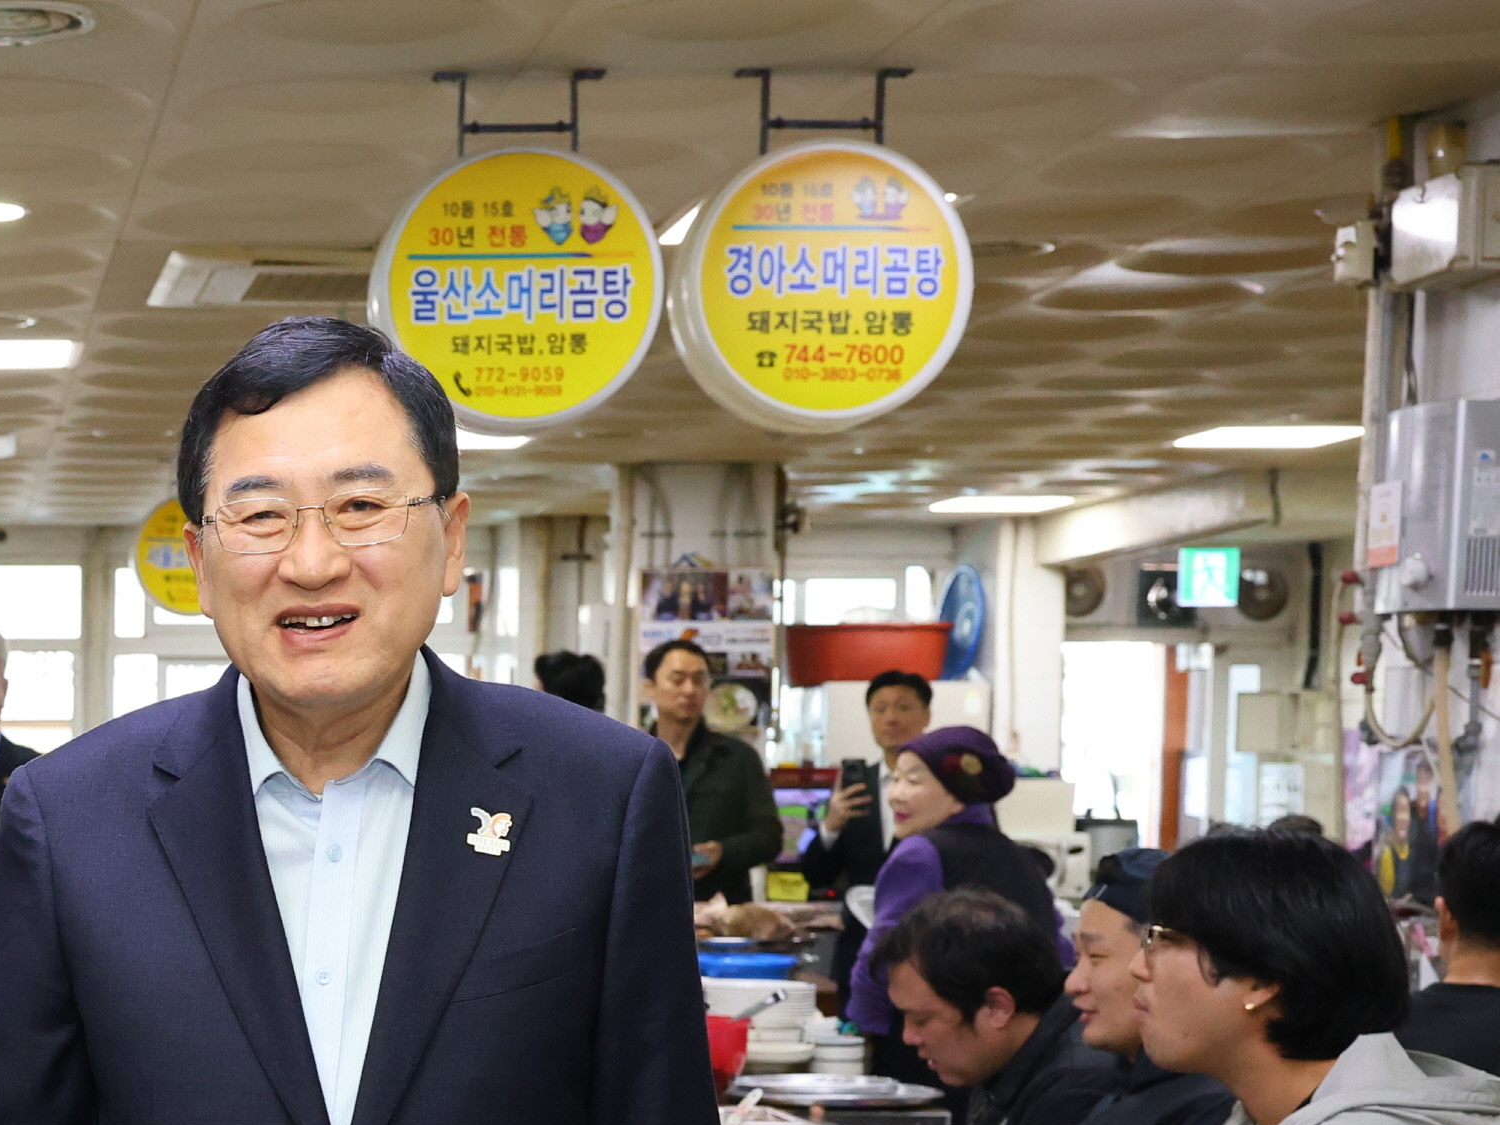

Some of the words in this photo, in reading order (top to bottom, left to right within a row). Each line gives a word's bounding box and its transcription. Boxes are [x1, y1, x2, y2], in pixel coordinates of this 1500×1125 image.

[443, 200, 475, 218] 10동
[483, 200, 514, 218] 15호
[753, 202, 791, 222] 30년
[801, 202, 835, 223] 전통
[428, 225, 476, 248] 30년
[488, 224, 528, 248] 전통
[726, 245, 943, 297] 경아소머리곰탕
[411, 266, 632, 321] 울산소머리곰탕
[784, 343, 905, 365] 744-7600
[475, 365, 565, 382] 772-9059
